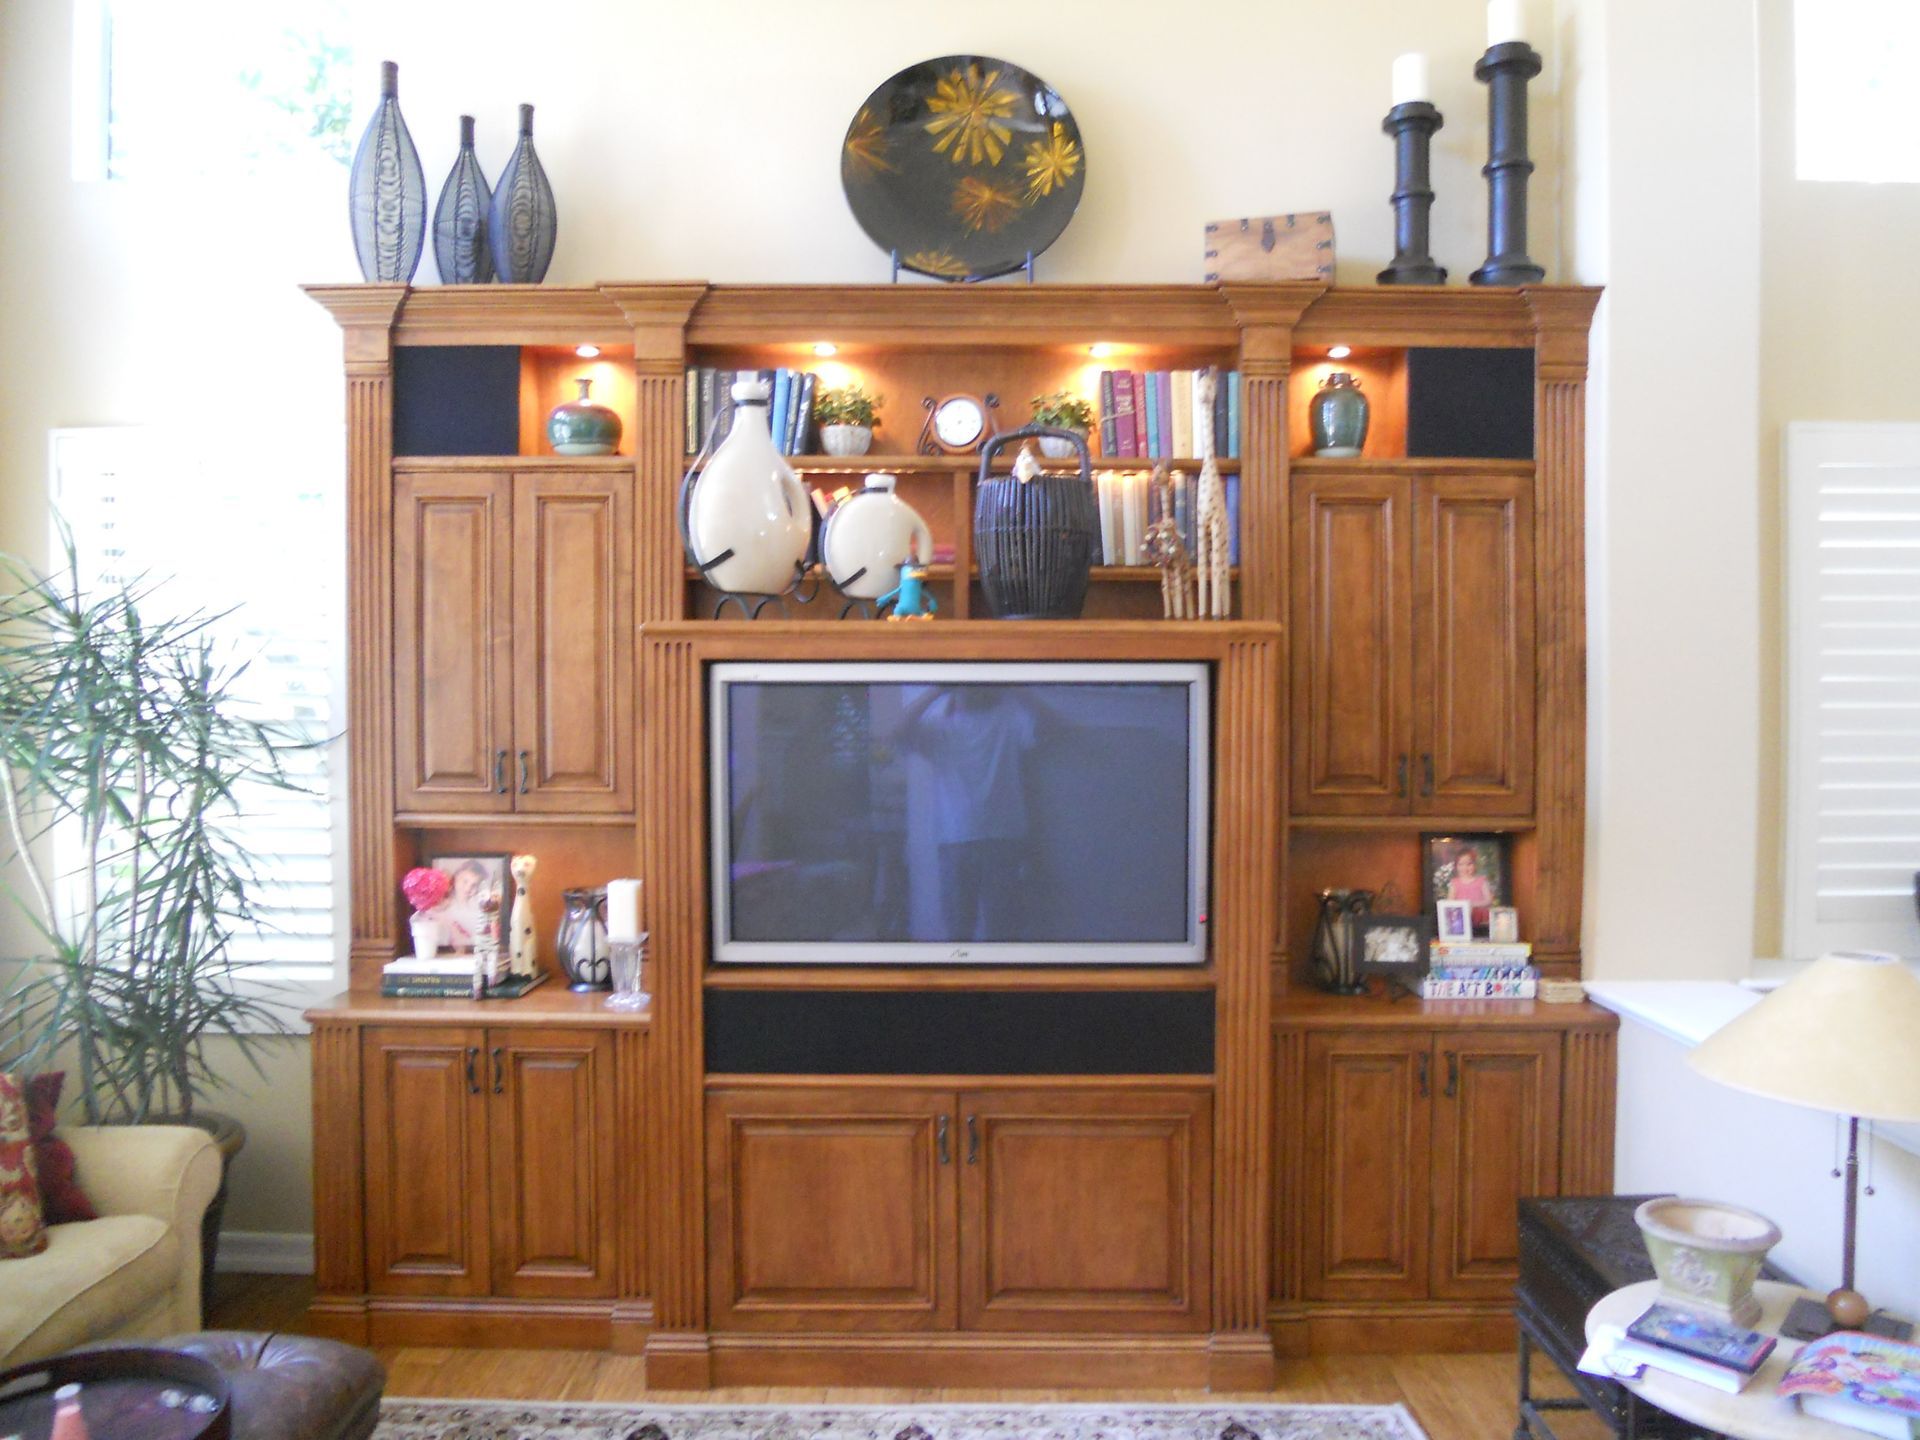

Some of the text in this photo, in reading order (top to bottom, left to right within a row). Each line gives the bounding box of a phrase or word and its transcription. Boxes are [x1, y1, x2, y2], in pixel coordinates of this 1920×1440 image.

[1429, 982, 1522, 997] THE ART BOOK
